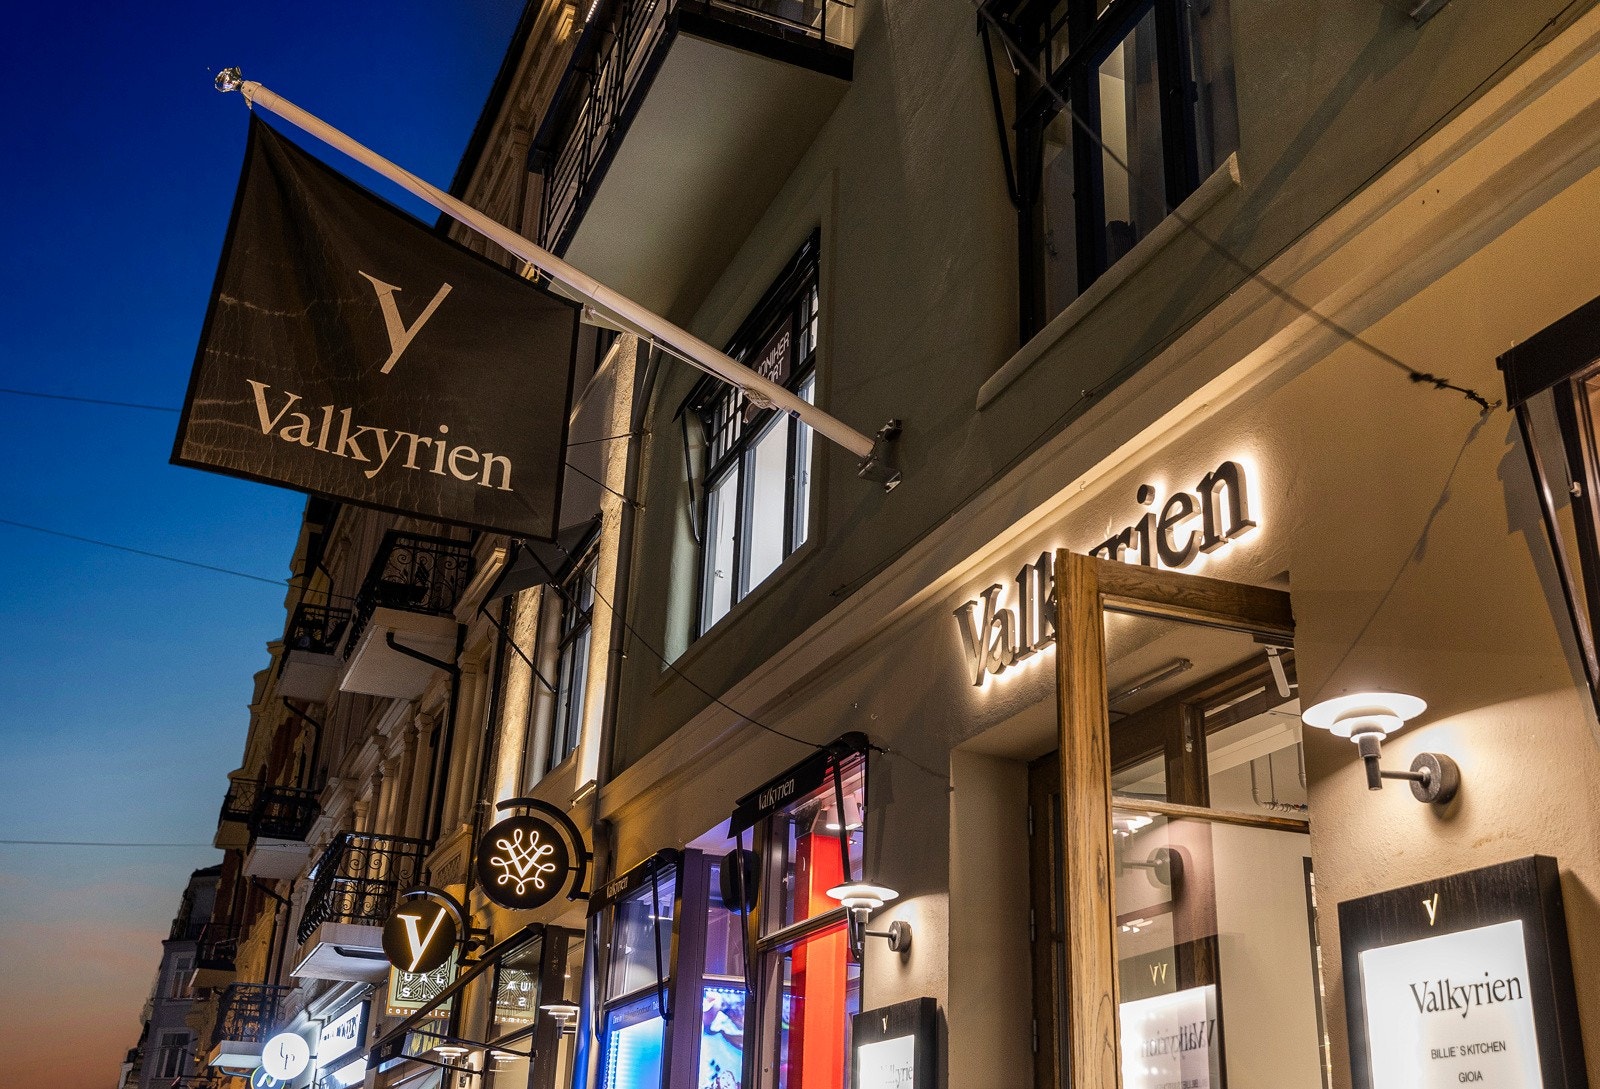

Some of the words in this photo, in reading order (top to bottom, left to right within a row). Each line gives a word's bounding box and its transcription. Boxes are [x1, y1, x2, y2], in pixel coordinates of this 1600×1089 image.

[246, 379, 514, 491] Valkyrien
[1409, 971, 1524, 1019] Valkyrien
[1467, 1041, 1507, 1056] KITCHEN
[1458, 1070, 1484, 1083] GIOIA
